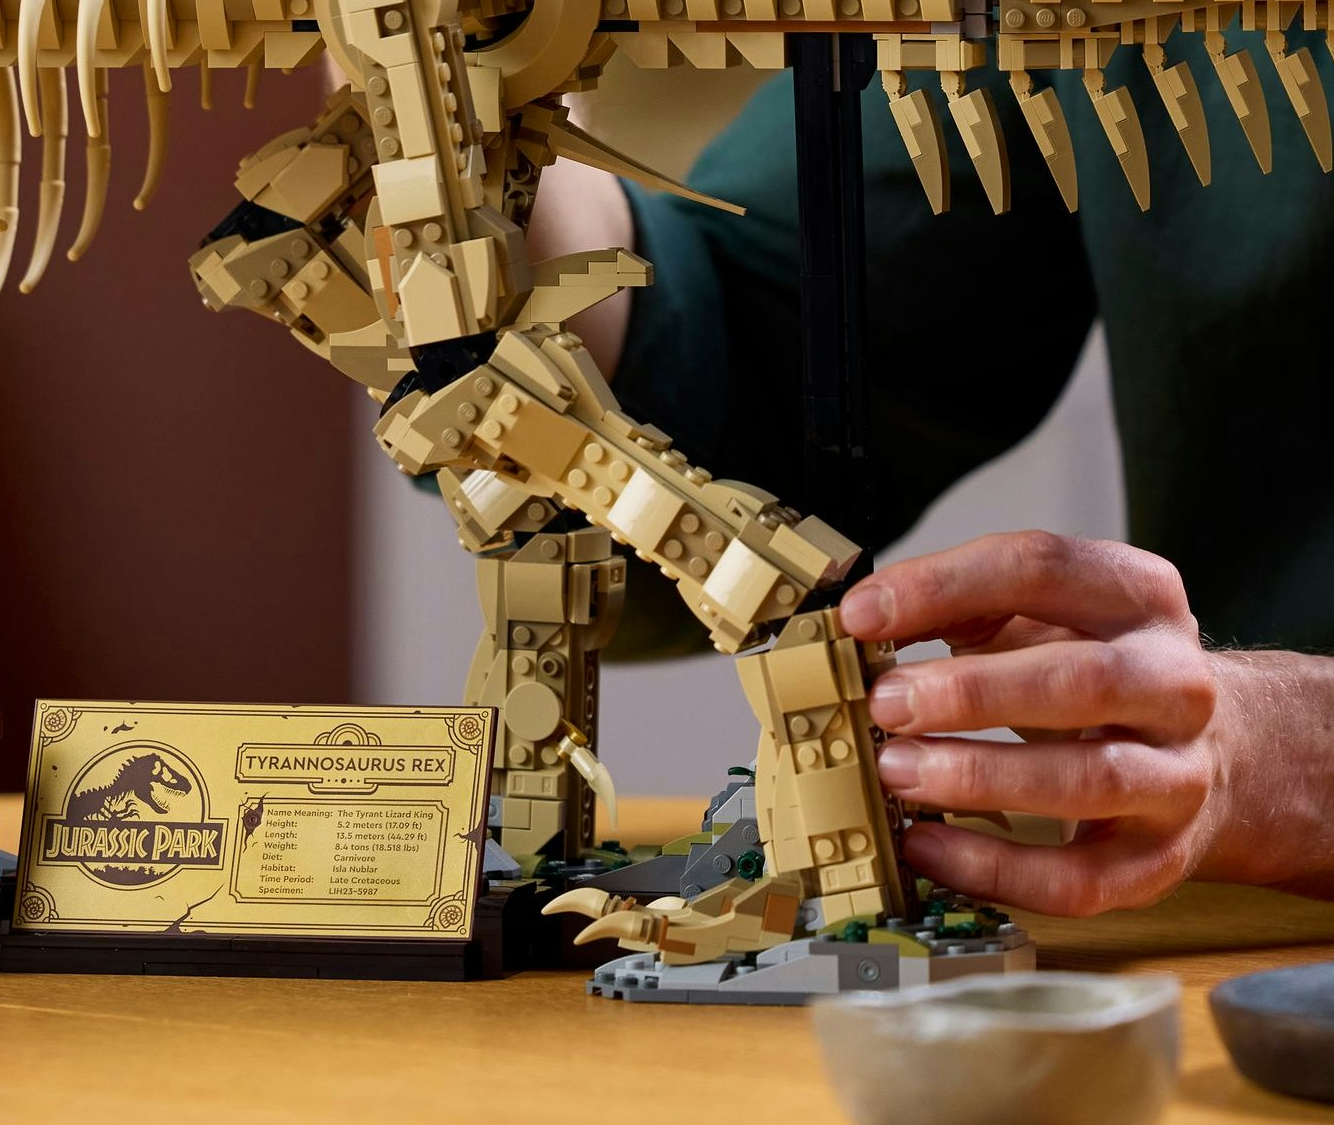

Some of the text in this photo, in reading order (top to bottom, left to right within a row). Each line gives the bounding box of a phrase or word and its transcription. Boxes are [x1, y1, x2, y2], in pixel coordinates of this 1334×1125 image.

[246, 756, 446, 772] TYRANNOSAURUS REX
[356, 811, 382, 819] Tyrant
[386, 810, 411, 818] Lizard
[414, 811, 433, 820] King
[267, 820, 297, 828] Height:
[386, 822, 410, 830] (17.09
[412, 822, 422, 830] ft)
[265, 831, 297, 839] Length:
[388, 833, 414, 841] (44.29
[417, 833, 427, 841] ft)
[46, 823, 218, 861] JURASSIC PARK
[264, 842, 297, 850] Weight:
[404, 844, 419, 852] lbs)
[334, 854, 375, 862] Carnivore
[261, 864, 295, 872] Habitat:
[259, 886, 303, 895] Specimen:
